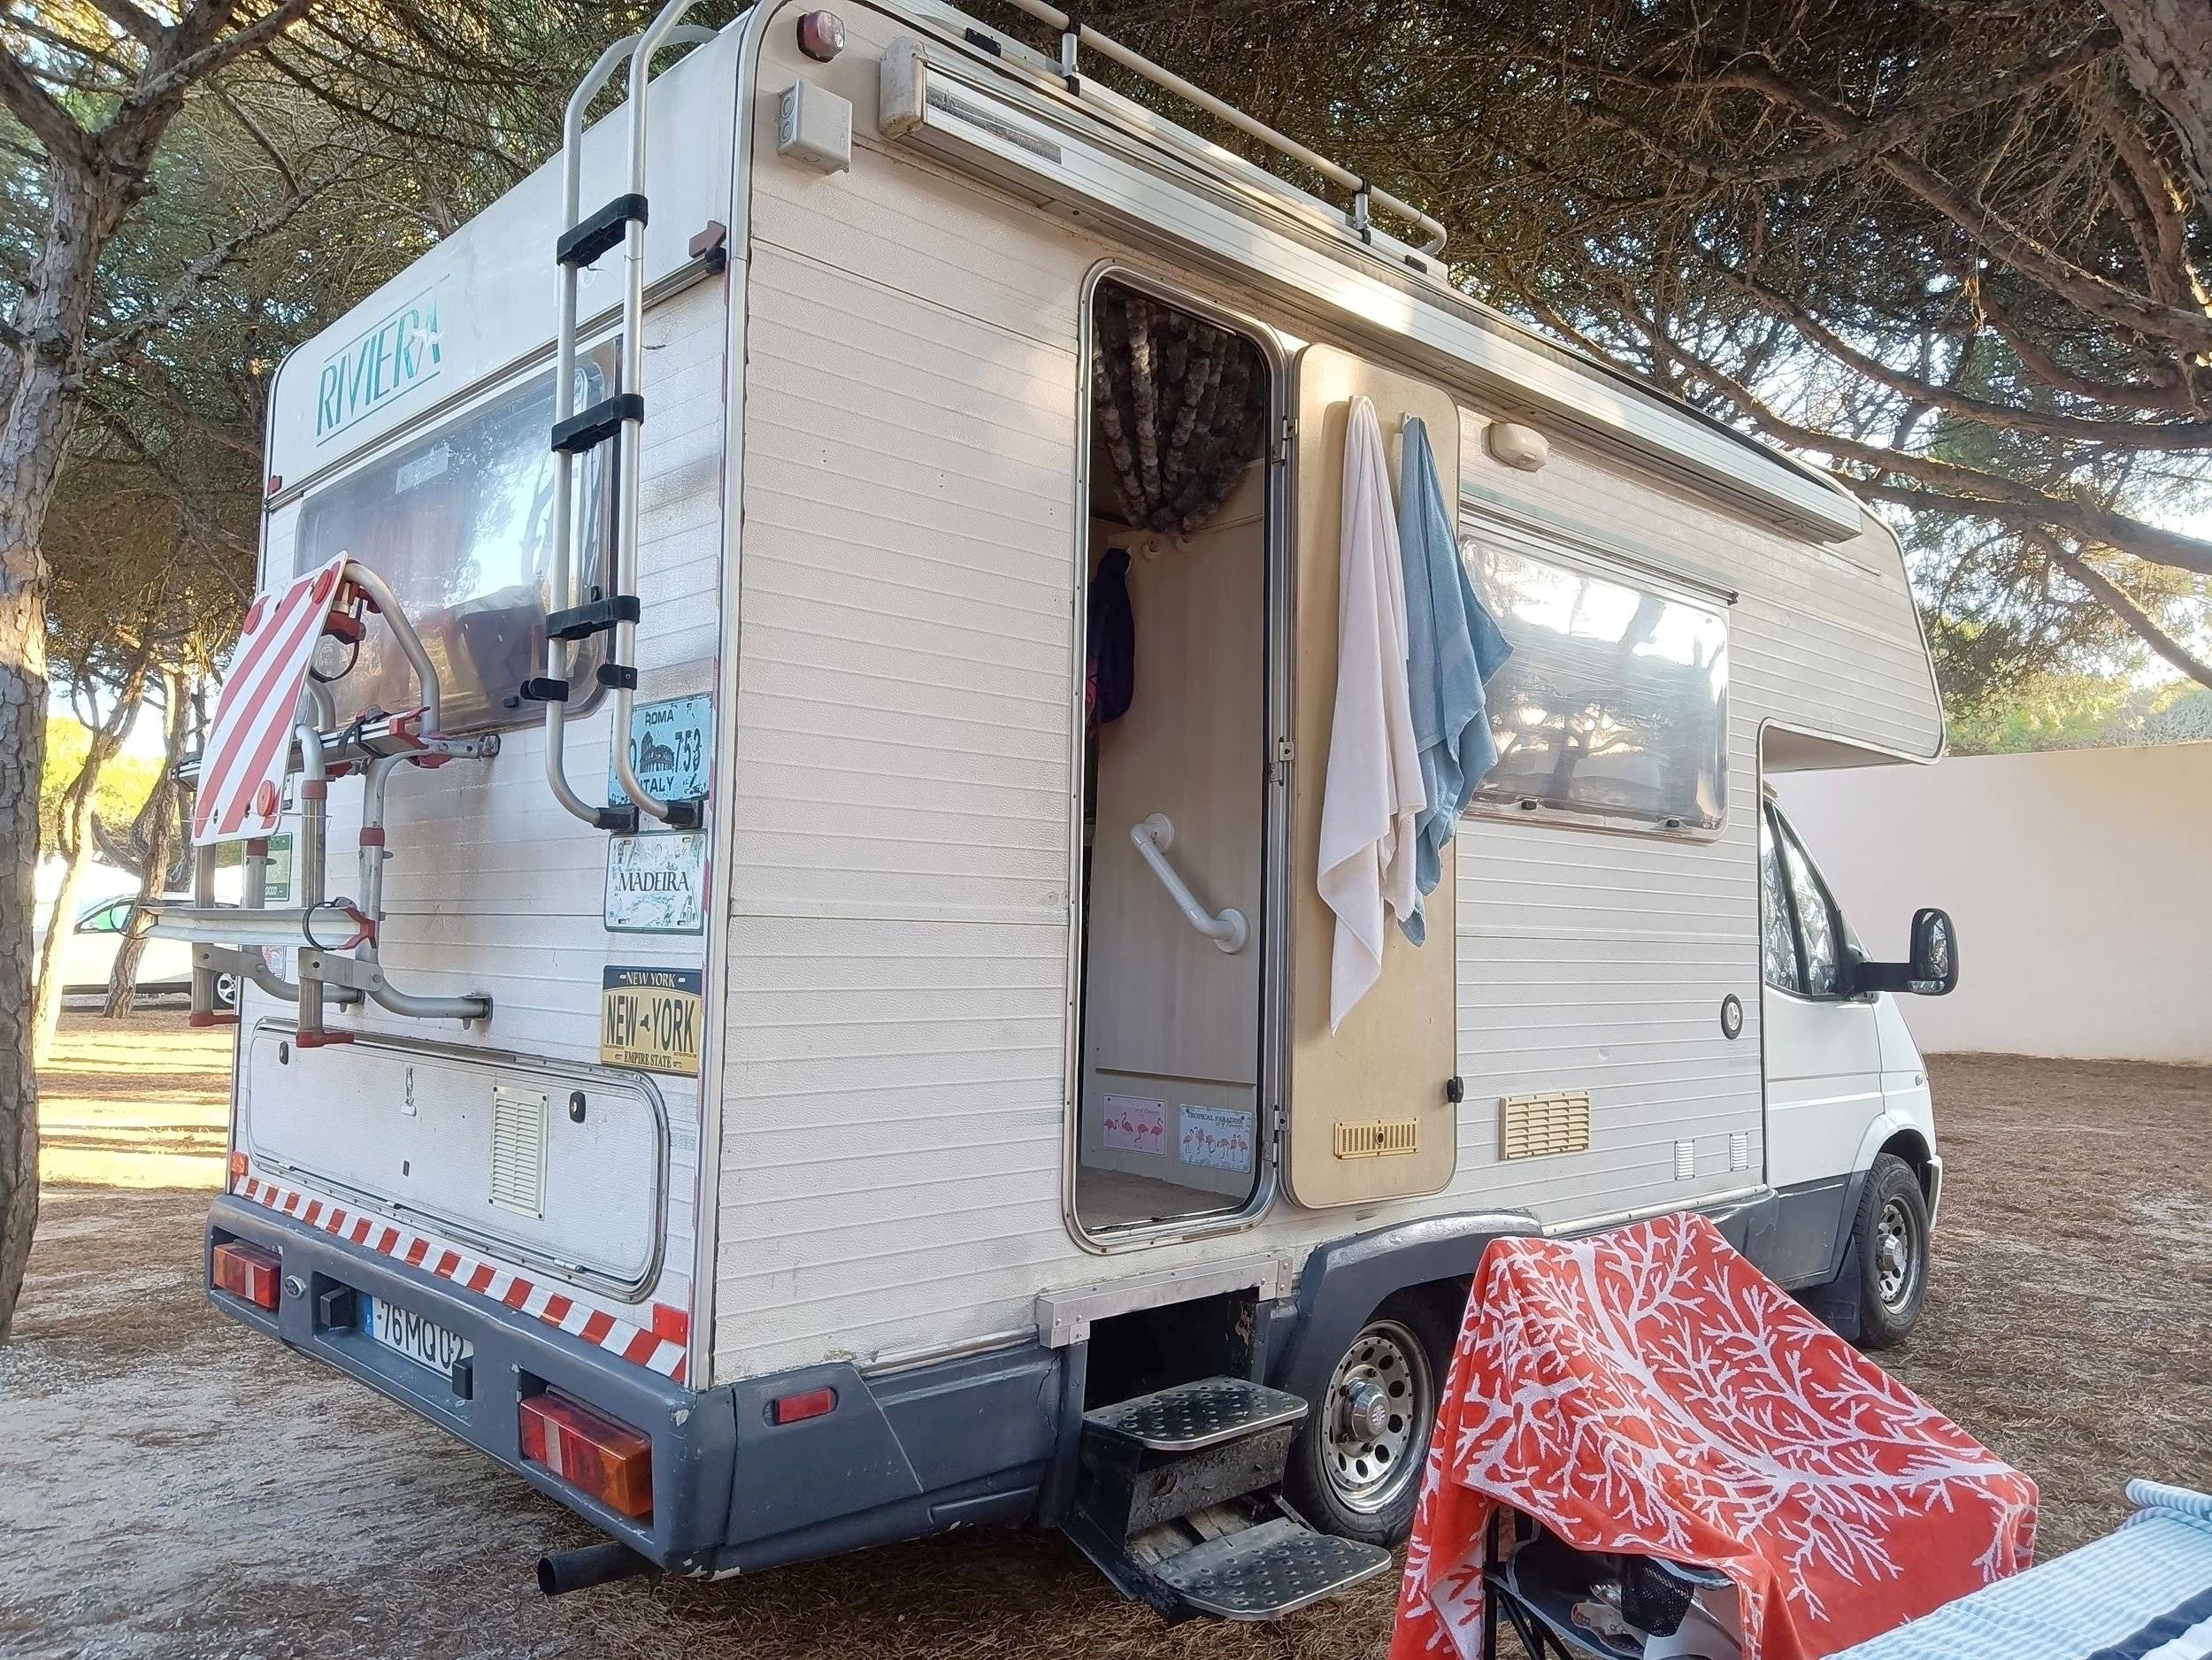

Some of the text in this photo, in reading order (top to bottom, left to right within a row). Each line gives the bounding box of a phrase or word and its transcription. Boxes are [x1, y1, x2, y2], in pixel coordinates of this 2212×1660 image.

[317, 299, 442, 436] RIVIERA
[645, 710, 674, 726] ROMA
[675, 727, 703, 773] 753
[618, 871, 690, 892] MADEIRA
[626, 972, 676, 988] NEW YORK
[606, 995, 695, 1053] NEW YORK
[624, 1050, 649, 1065] EMPIRE
[649, 1054, 672, 1069] STATE
